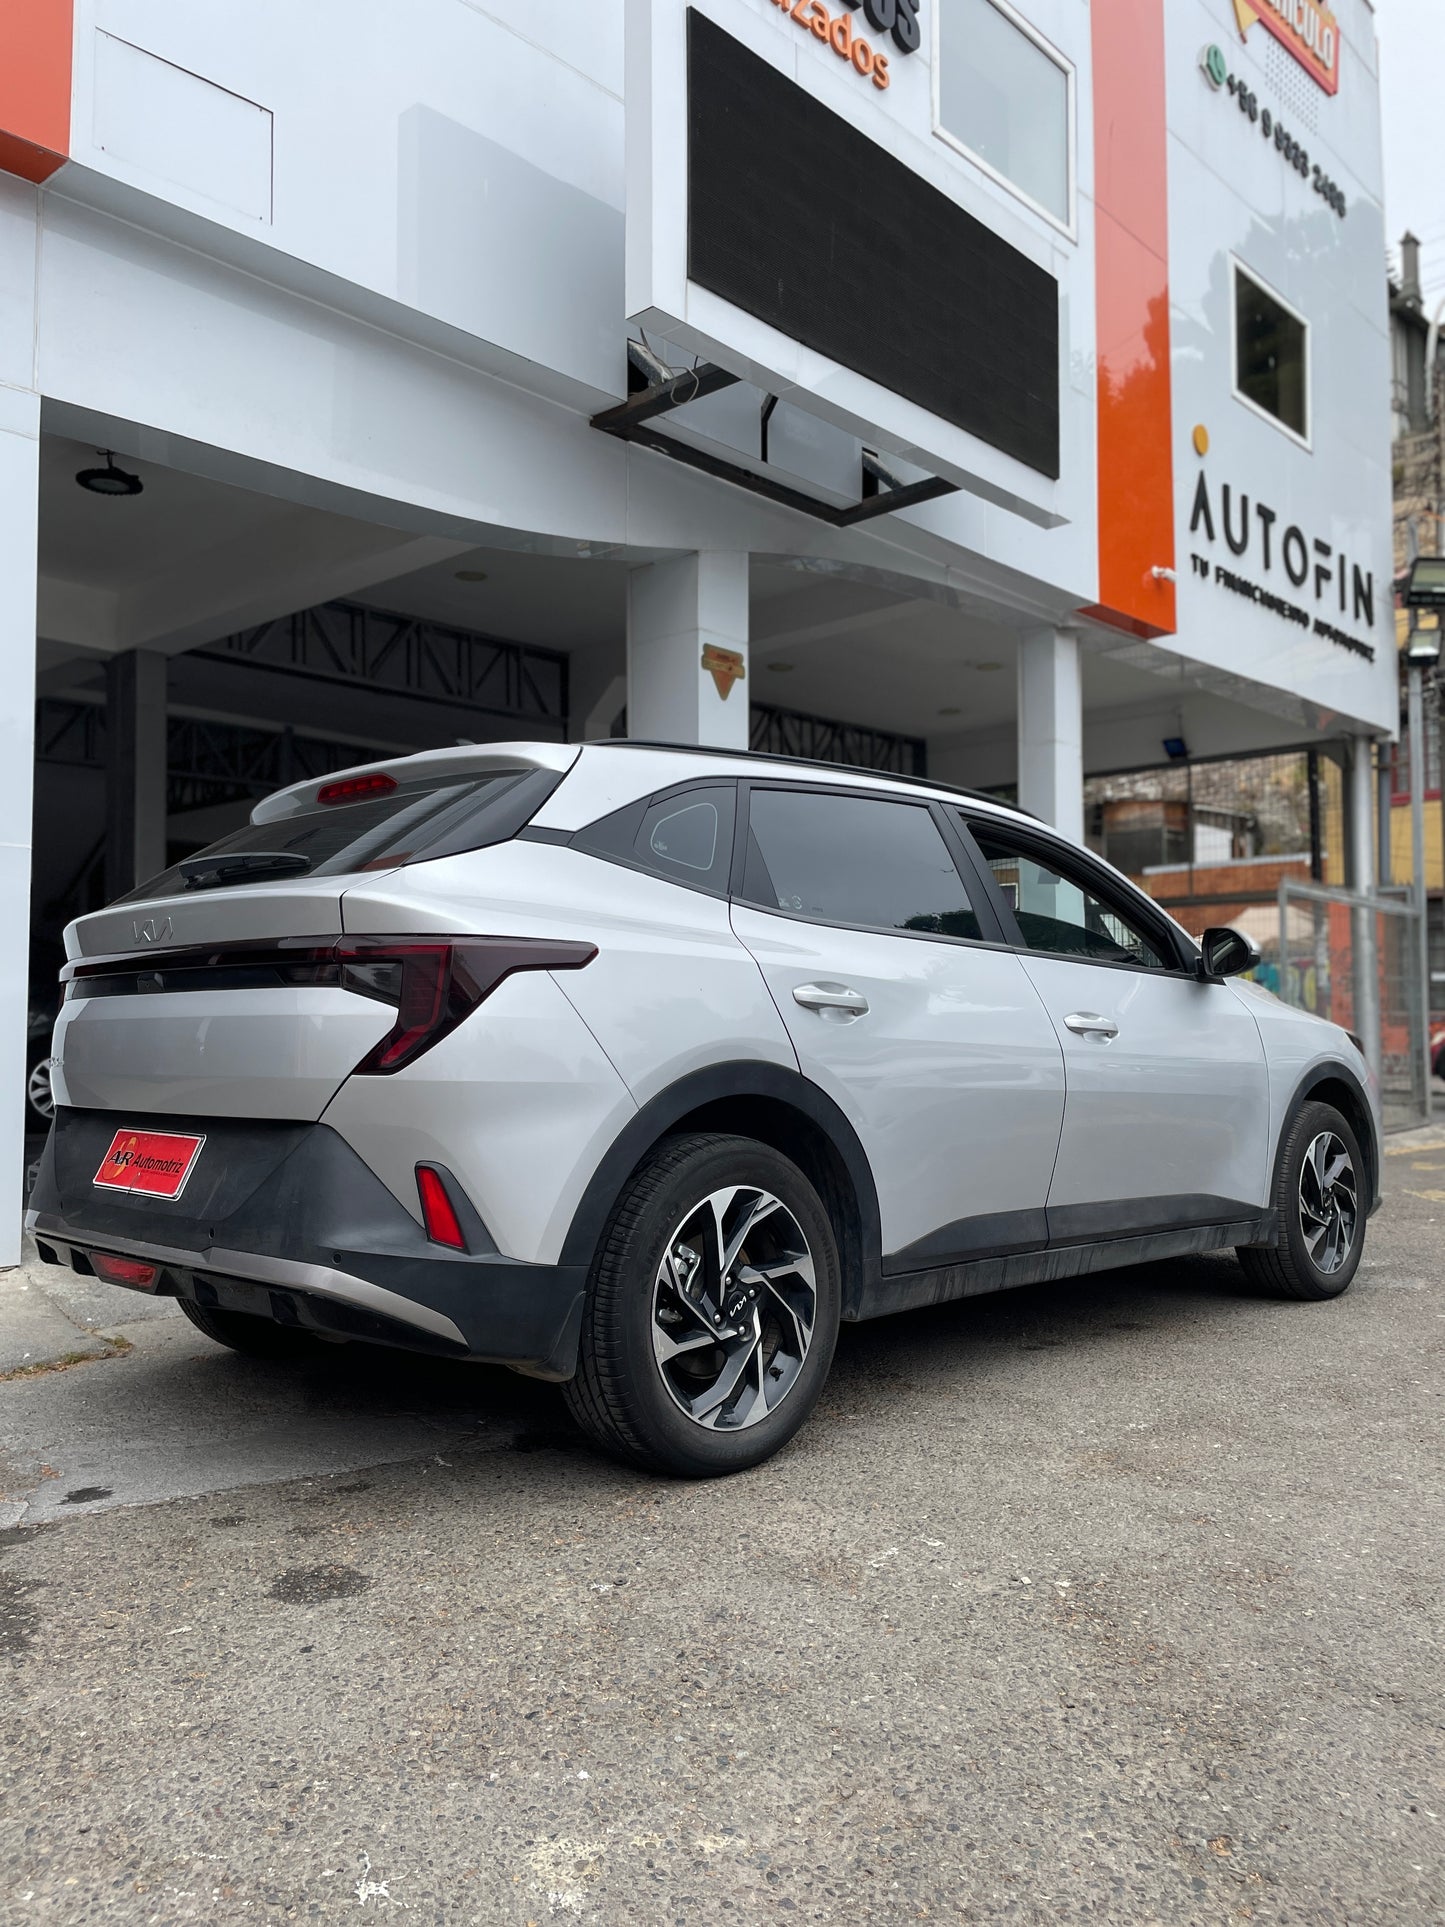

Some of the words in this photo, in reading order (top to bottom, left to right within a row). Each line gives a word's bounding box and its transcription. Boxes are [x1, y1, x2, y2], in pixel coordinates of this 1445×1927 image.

[1189, 468, 1375, 628] AUTOFIN
[1190, 553, 1209, 579] TU
[133, 917, 173, 944] KIA
[132, 1153, 184, 1174] Automotriz
